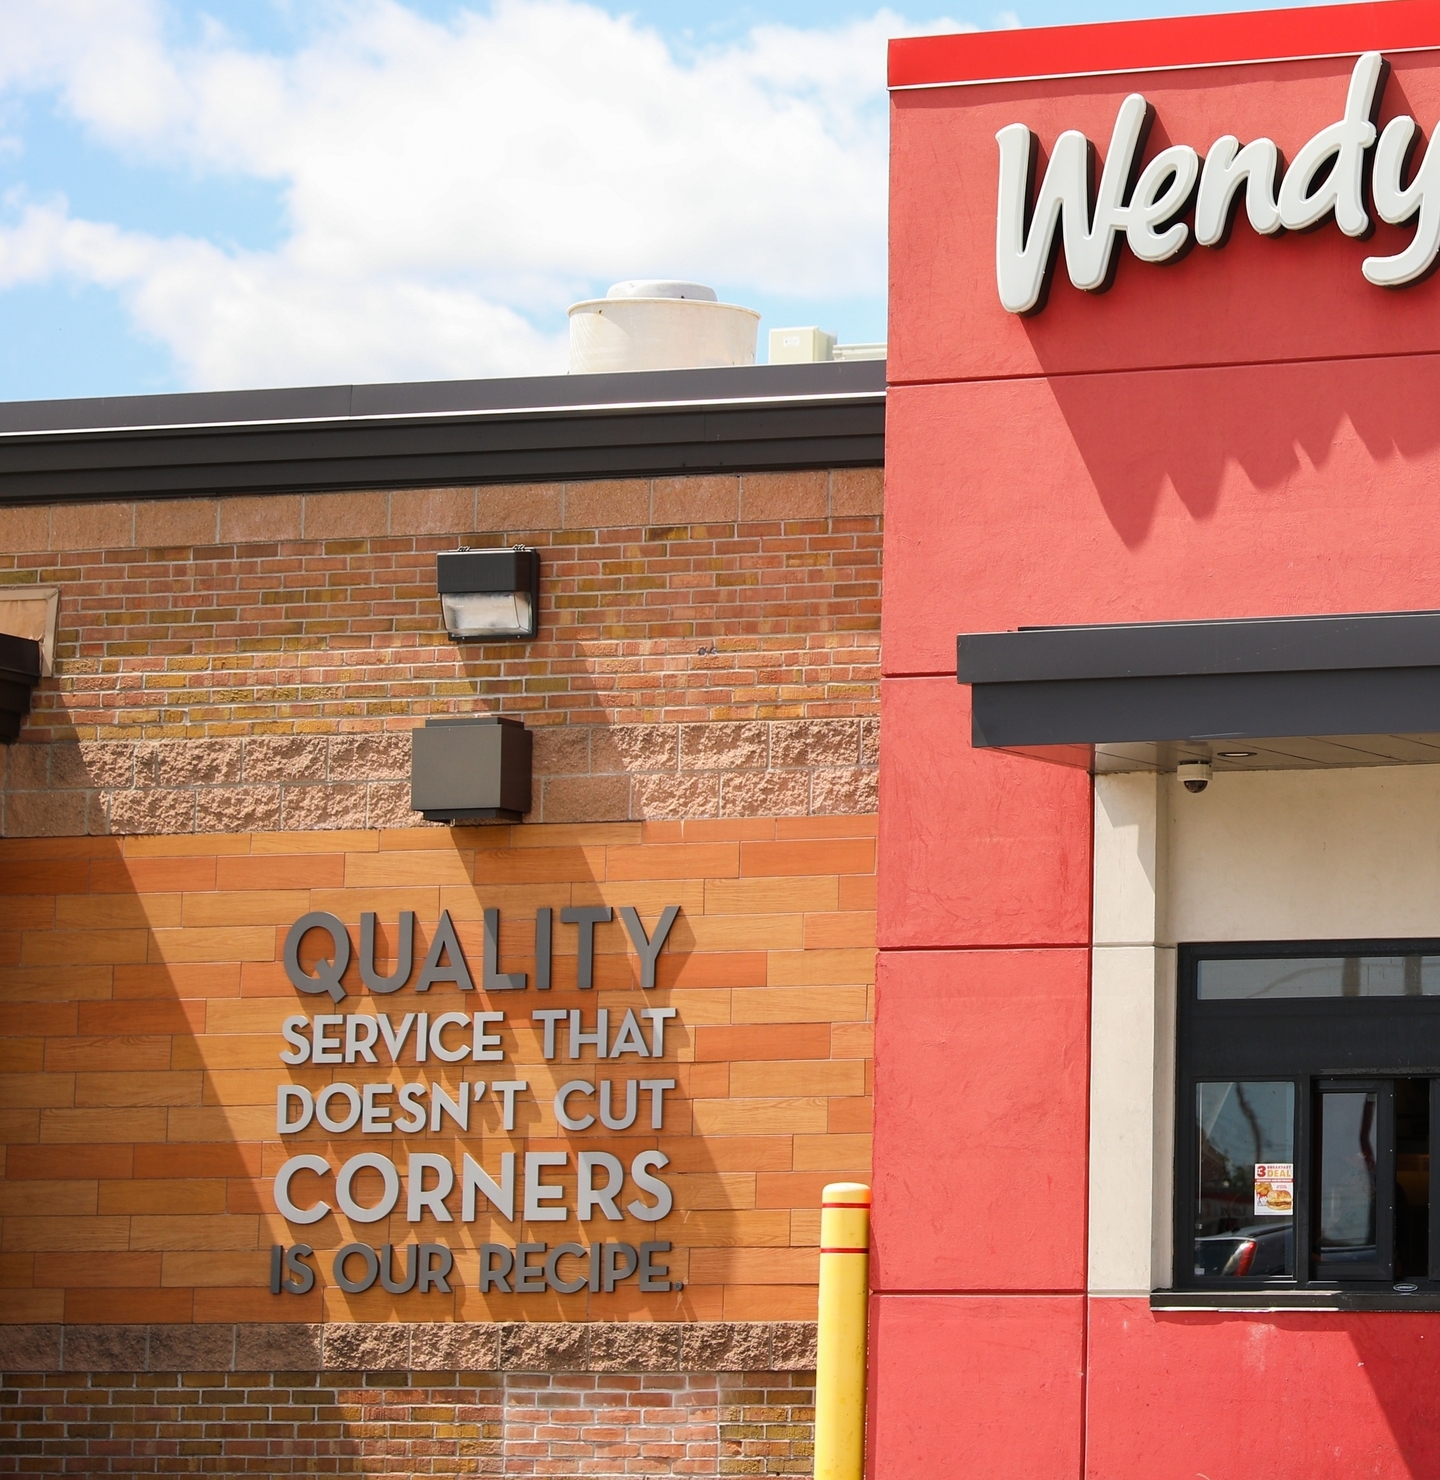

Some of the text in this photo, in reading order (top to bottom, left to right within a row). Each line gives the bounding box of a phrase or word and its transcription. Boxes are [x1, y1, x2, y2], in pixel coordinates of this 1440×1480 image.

[283, 906, 681, 1004] QUALITY
[279, 1008, 677, 1065] SERVICE THAT
[276, 1079, 676, 1134] DOESN'T CUT
[274, 1150, 673, 1224] CORNERS
[270, 1244, 315, 1294] IS
[333, 1242, 454, 1293] OUR
